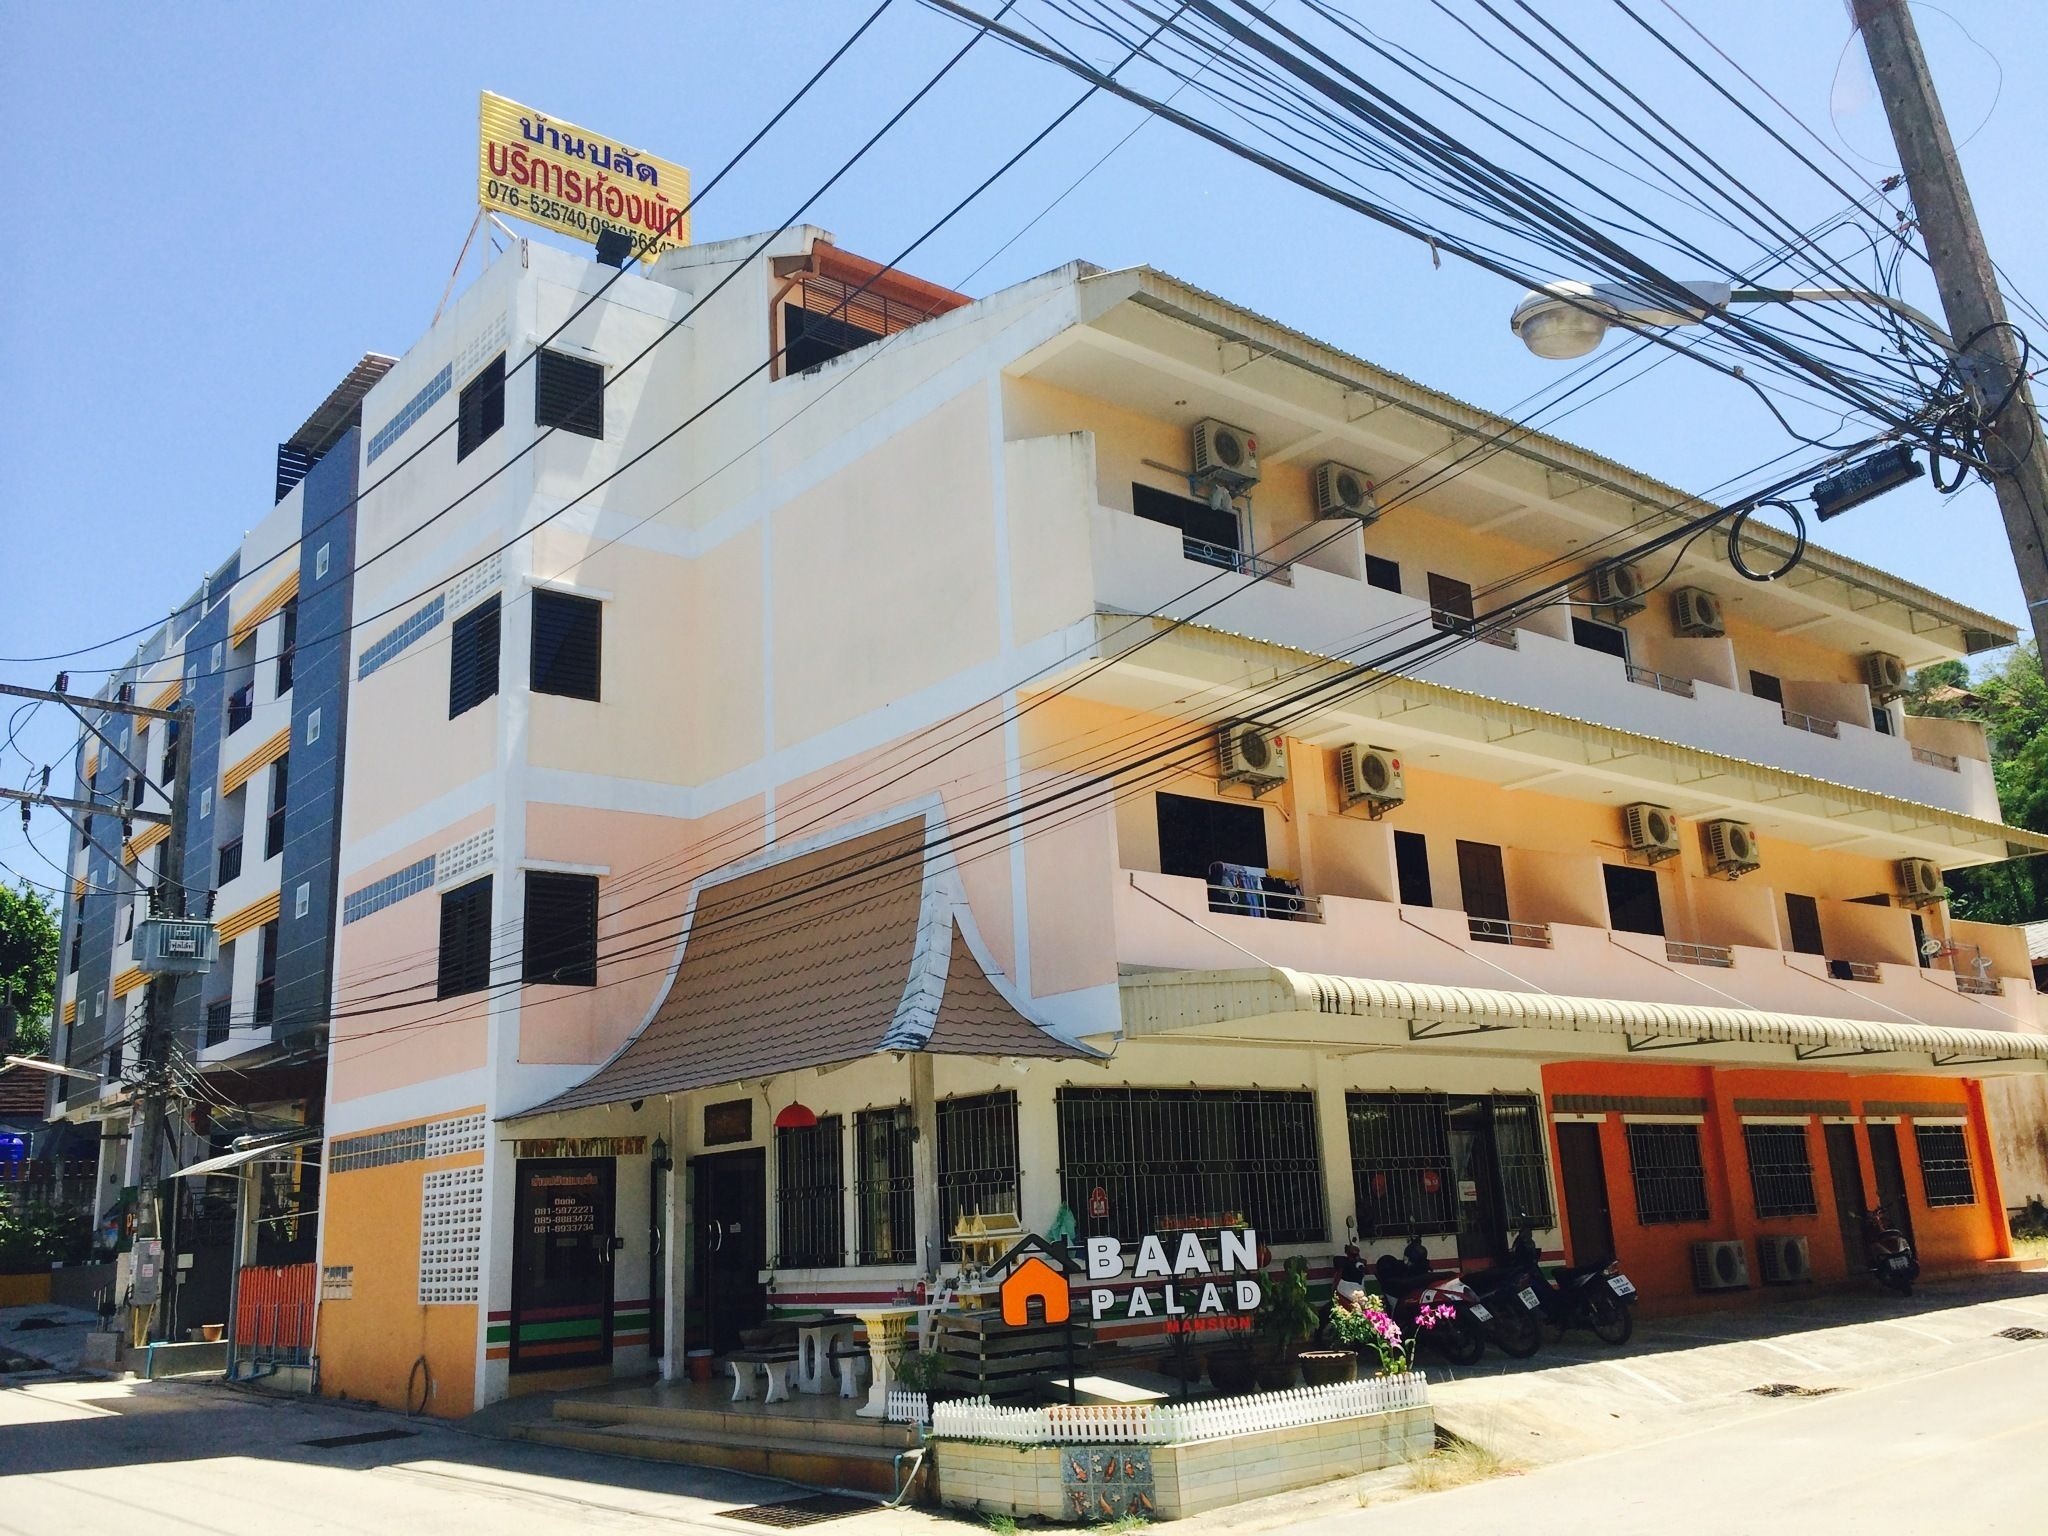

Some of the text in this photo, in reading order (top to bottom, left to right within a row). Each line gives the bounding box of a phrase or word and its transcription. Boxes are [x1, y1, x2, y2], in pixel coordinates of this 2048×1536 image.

[519, 114, 658, 187] บ้านปลัด
[488, 140, 684, 241] บริการห้องพัก
[1087, 1229, 1258, 1280] BAAN
[1091, 1280, 1262, 1320] PALAD
[1165, 1316, 1251, 1333] MANSION
